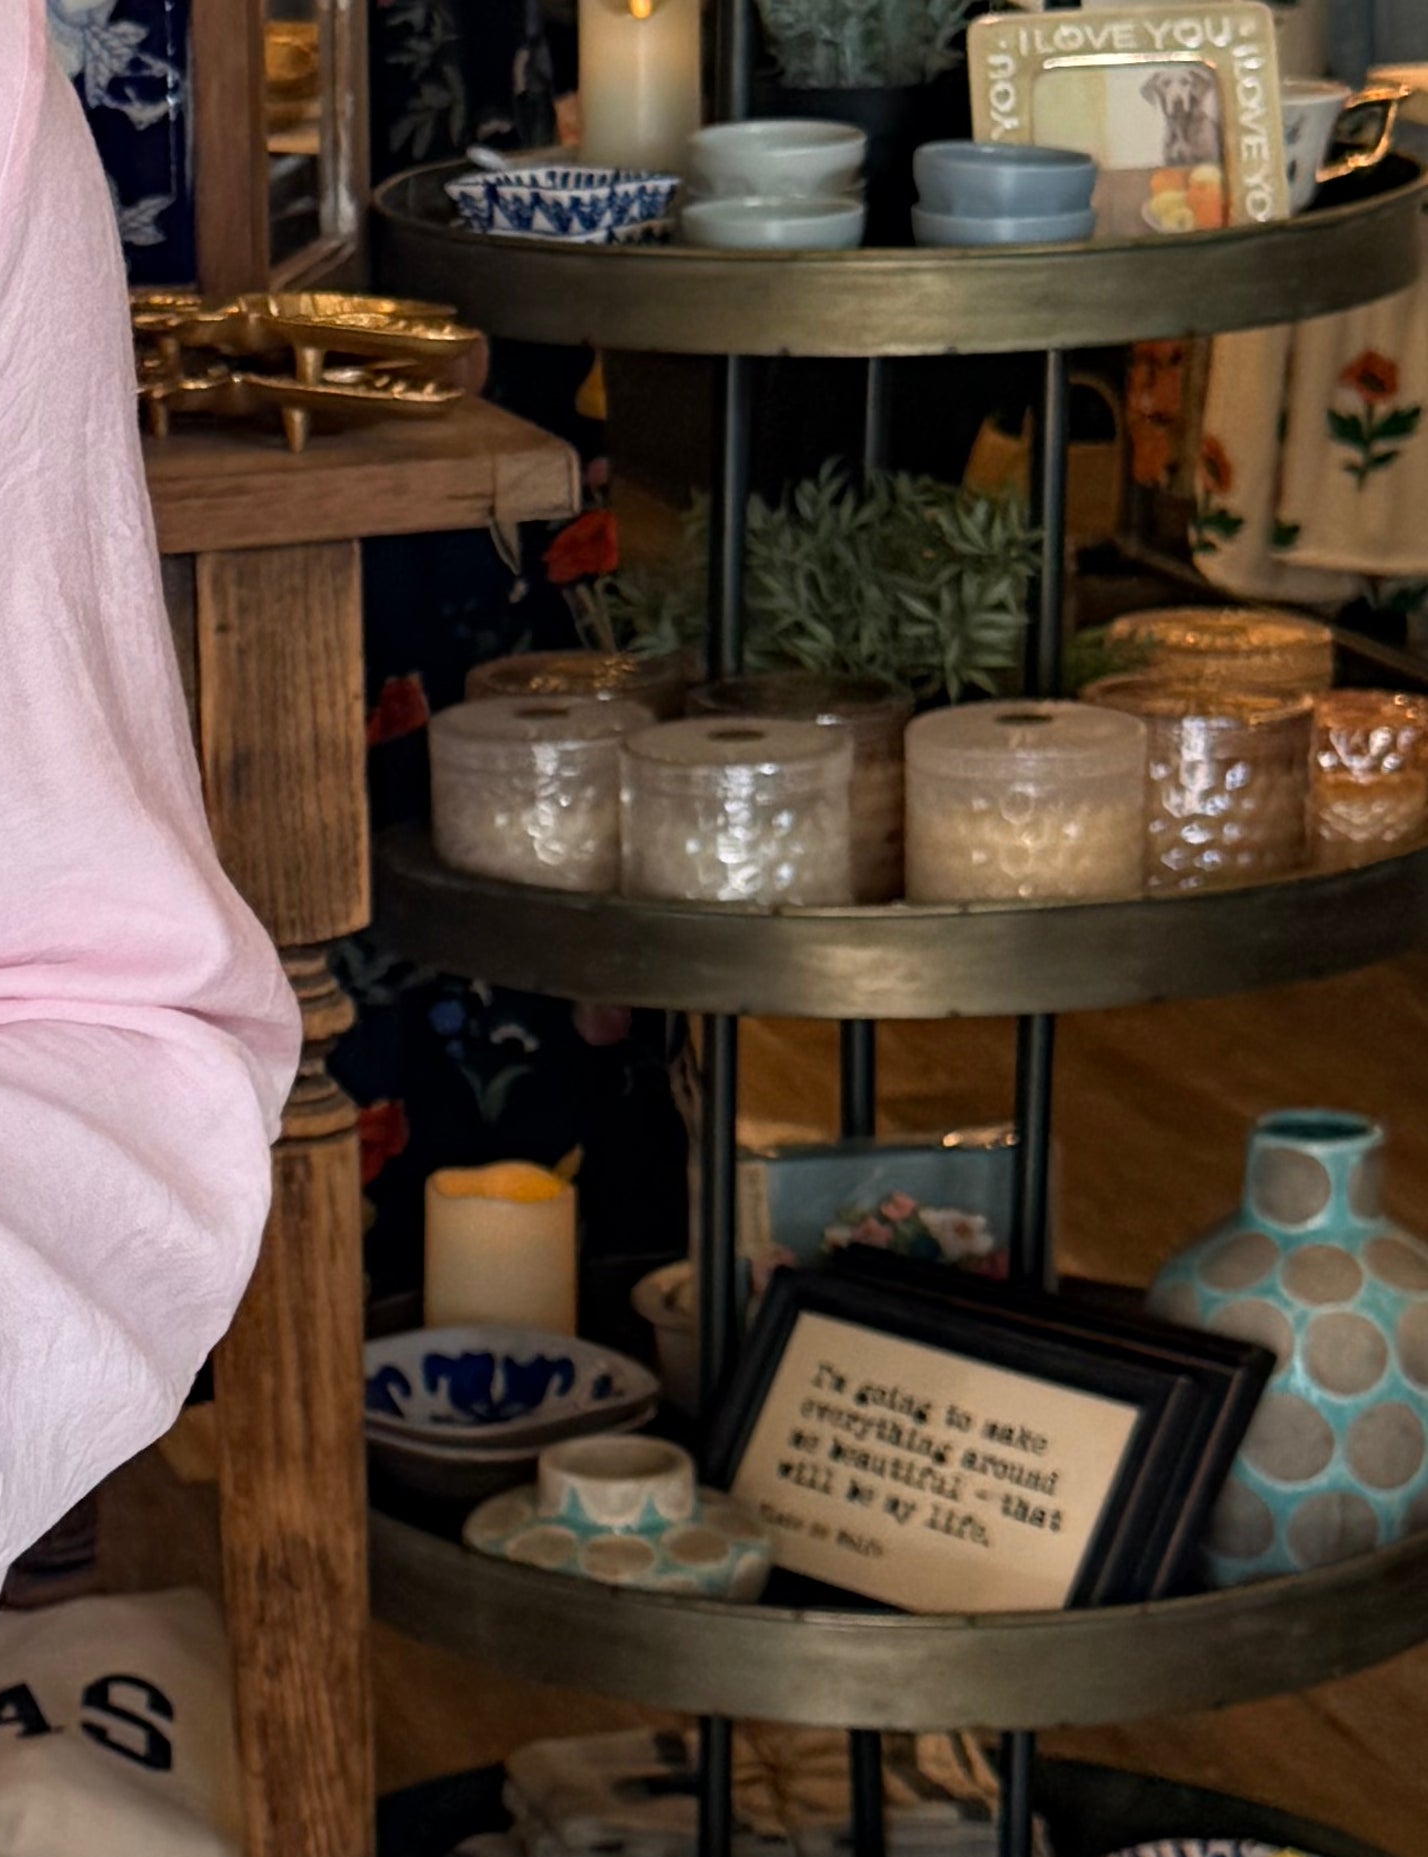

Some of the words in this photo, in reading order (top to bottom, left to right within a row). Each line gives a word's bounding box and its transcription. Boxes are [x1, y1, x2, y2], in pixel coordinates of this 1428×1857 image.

[1034, 22, 1135, 54] LOVE
[1143, 15, 1232, 48] YOU
[1245, 159, 1275, 223] YO
[853, 1381, 932, 1426] going
[945, 1404, 973, 1434] to
[800, 1398, 952, 1464] everything
[961, 1447, 1060, 1495] around
[828, 1436, 962, 1501] beautiful
[1000, 1493, 1063, 1533] that
